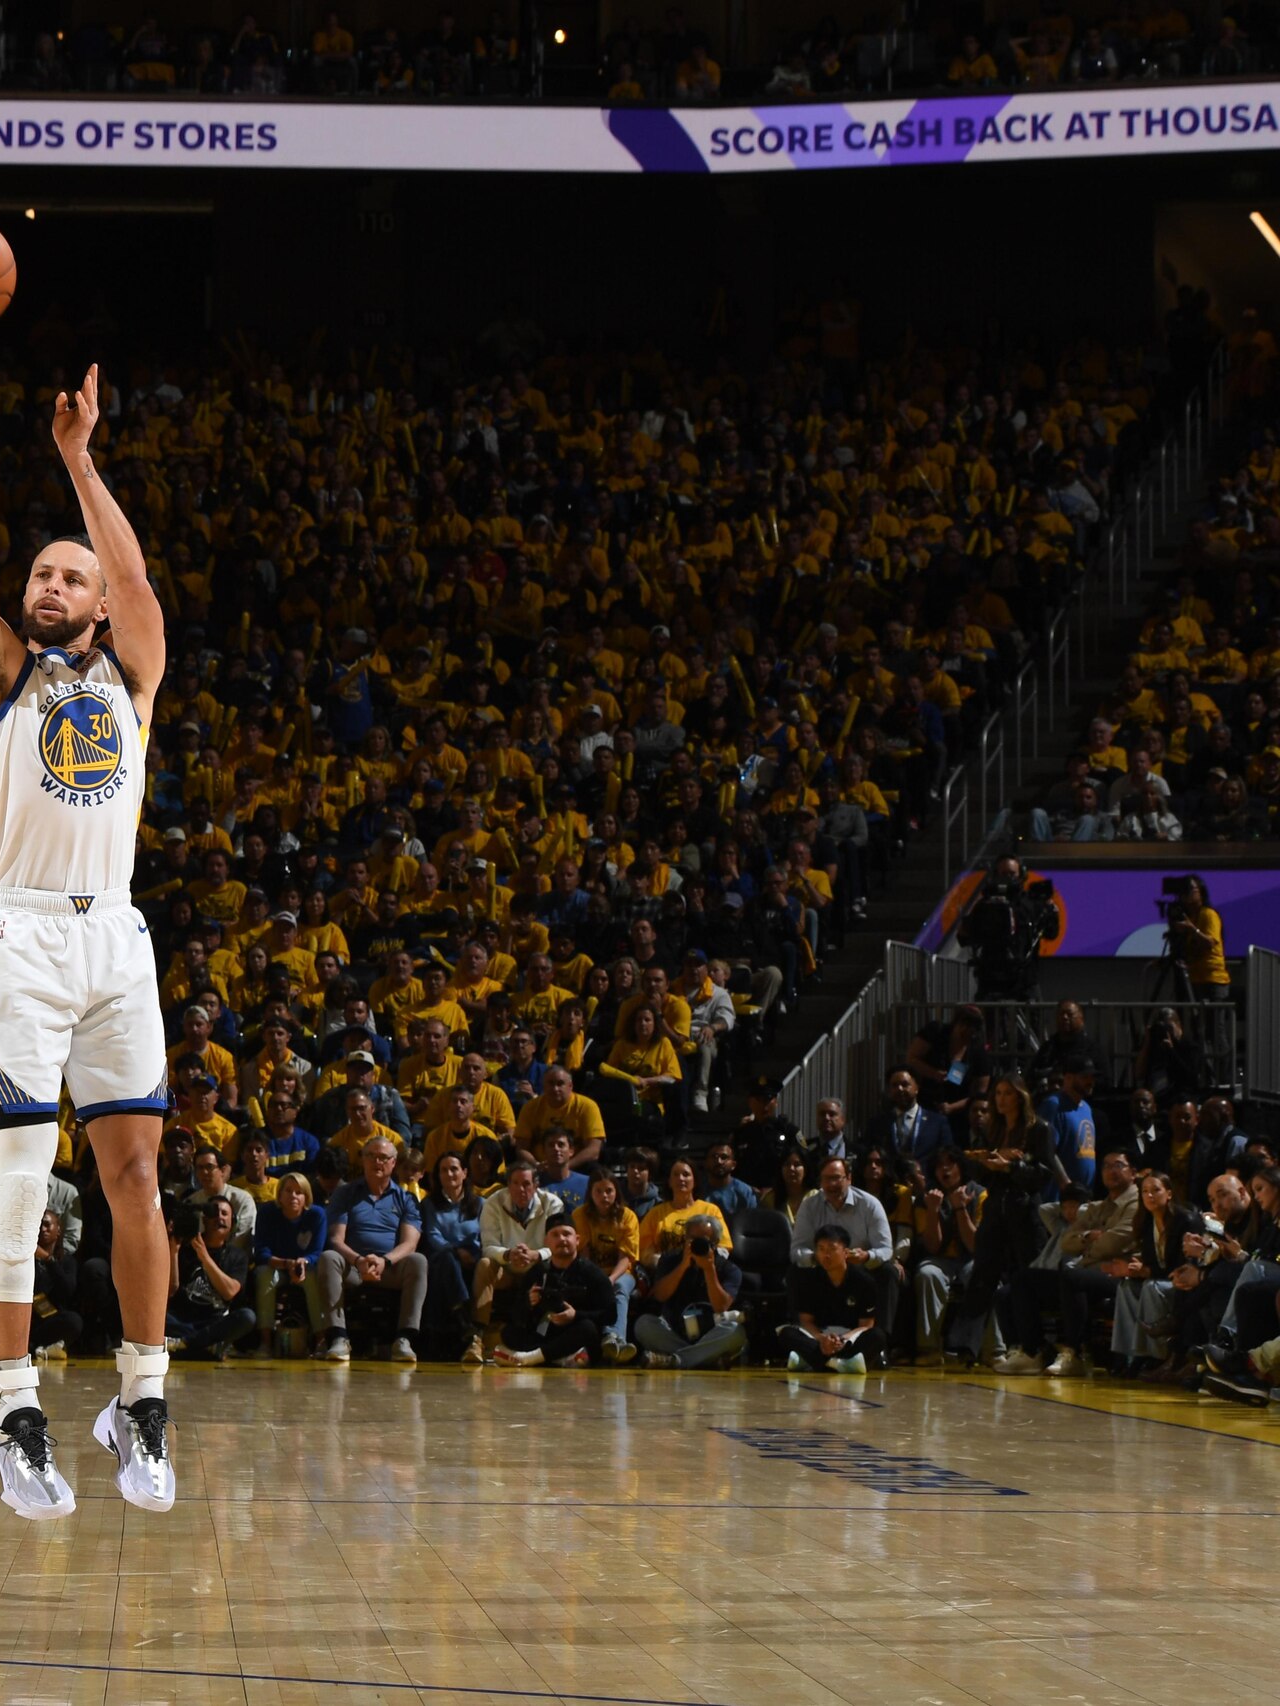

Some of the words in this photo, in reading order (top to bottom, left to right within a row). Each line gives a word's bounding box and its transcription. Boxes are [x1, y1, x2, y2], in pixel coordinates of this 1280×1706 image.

[76, 121, 125, 149] OF
[134, 121, 278, 151] STORES
[710, 123, 834, 156] SCORE
[842, 116, 944, 152] CASH
[953, 113, 1054, 147] BACK
[1064, 110, 1111, 140] AT
[1119, 103, 1279, 137] THOUSA
[39, 682, 82, 714] GOLDEN
[84, 683, 115, 708] STATE
[88, 712, 113, 742] 30
[39, 765, 128, 808] WARRIORS
